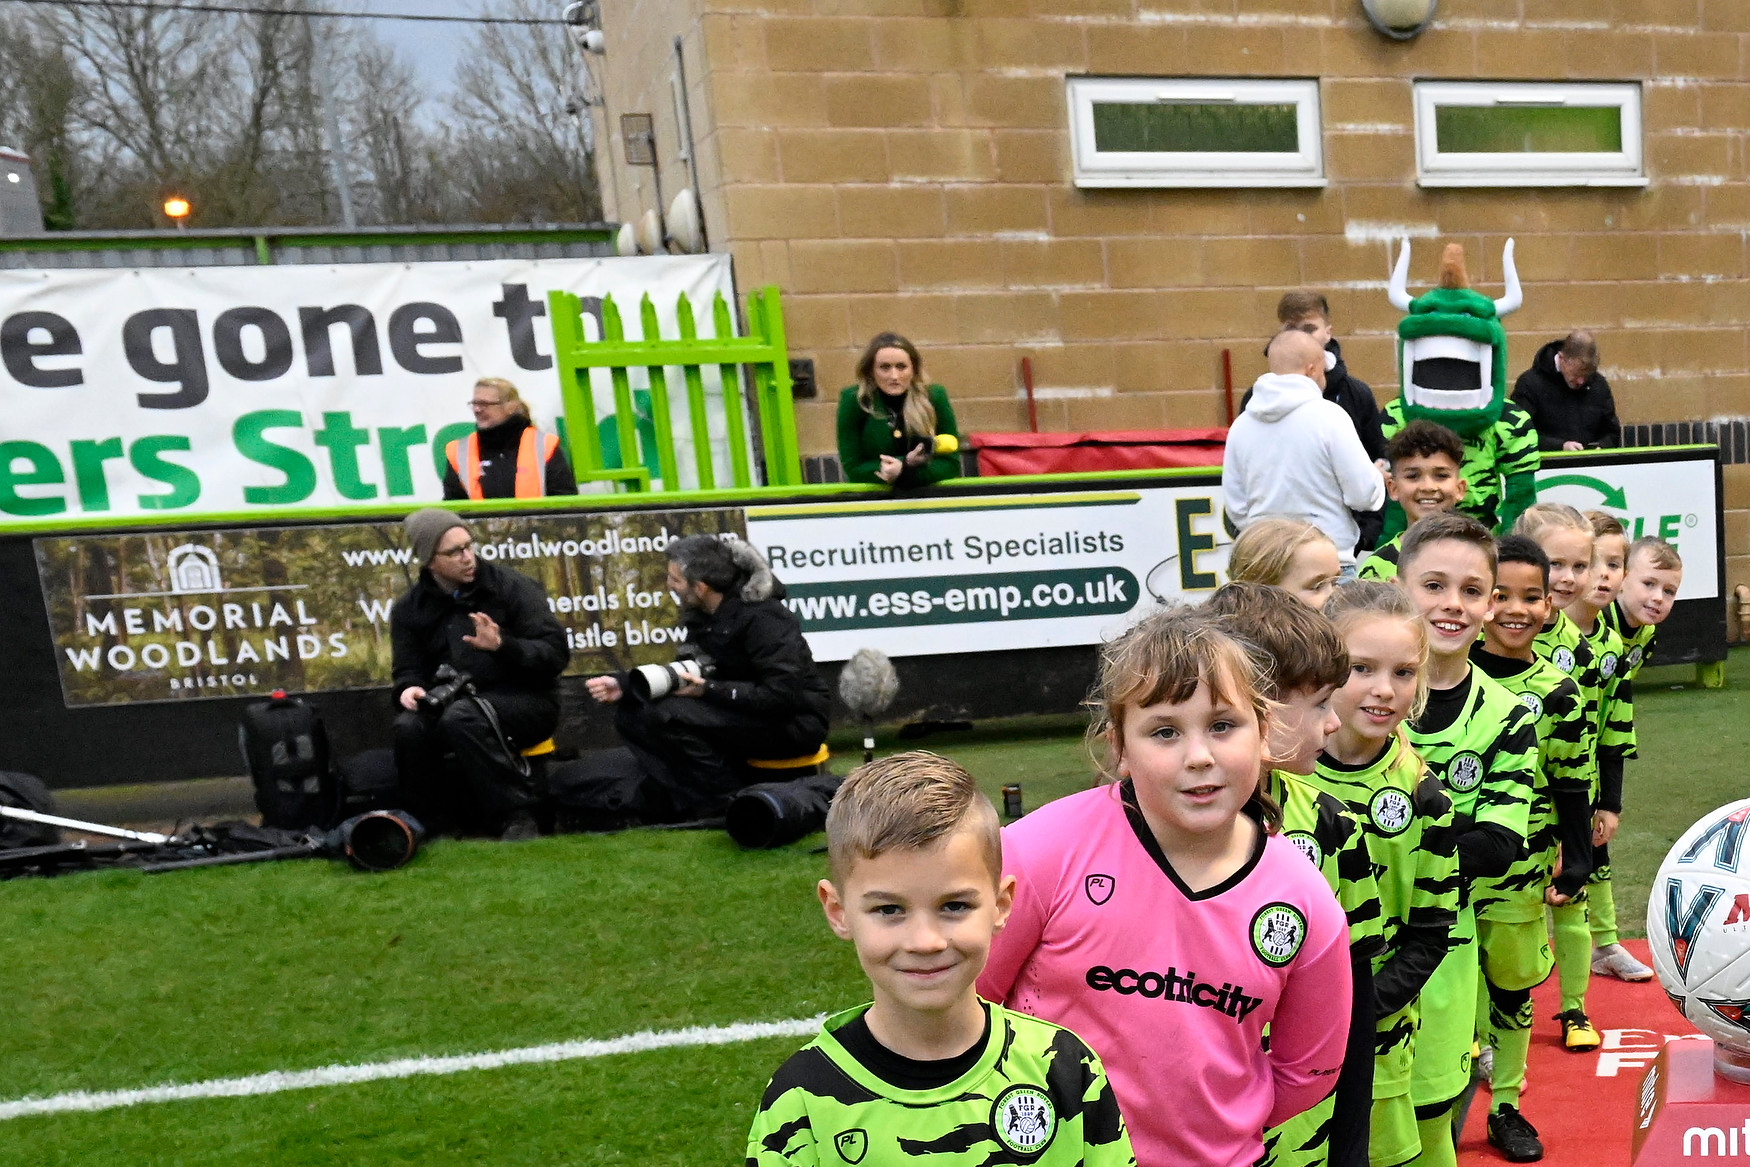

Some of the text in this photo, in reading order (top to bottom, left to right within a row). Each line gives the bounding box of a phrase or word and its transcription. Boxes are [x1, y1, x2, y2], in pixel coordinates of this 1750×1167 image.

[122, 301, 464, 410] gone
[766, 530, 1125, 570] Recruitment Specialists
[626, 583, 664, 609] for
[85, 600, 318, 637] MEMORIAL
[65, 632, 349, 673] WOODLANDS
[169, 674, 259, 690] BRISTOL
[1089, 878, 1106, 888] PL
[1085, 966, 1264, 1025] ecotricity
[840, 1134, 857, 1147] PL
